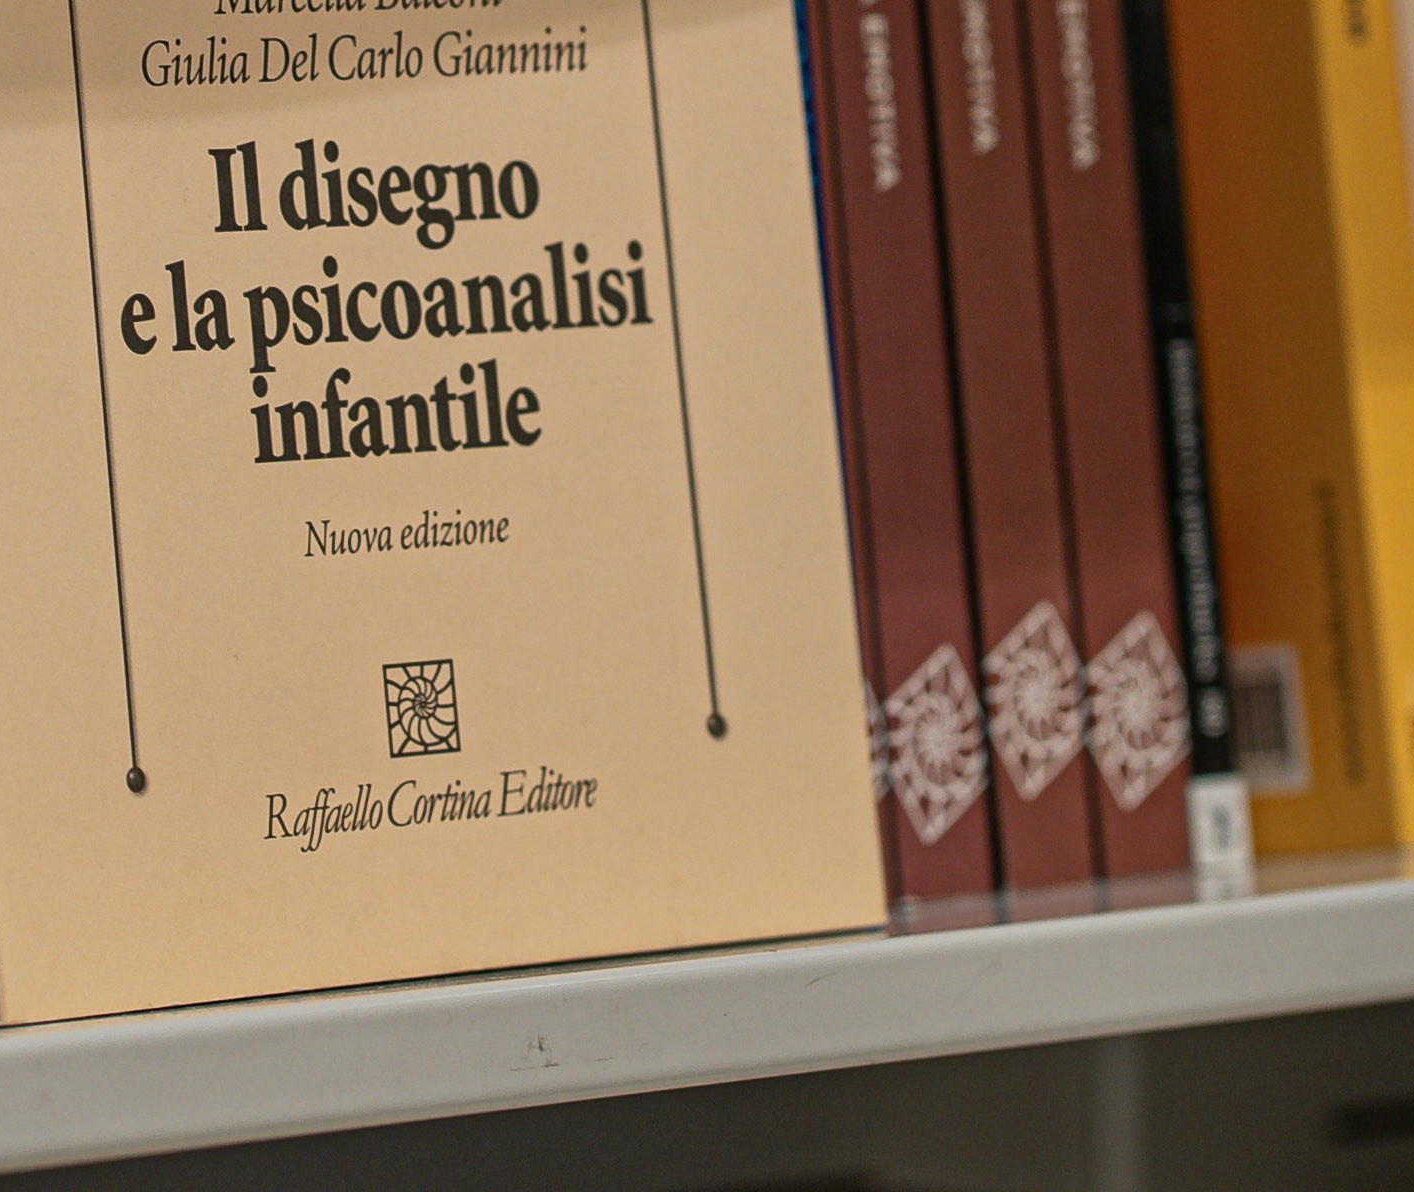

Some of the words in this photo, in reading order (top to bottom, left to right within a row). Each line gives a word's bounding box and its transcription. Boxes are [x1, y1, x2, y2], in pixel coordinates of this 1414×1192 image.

[141, 36, 250, 87] Giulia
[258, 34, 320, 83] Del
[328, 31, 423, 80] Carlo
[433, 24, 588, 78] Giannini
[208, 140, 268, 233] Il
[279, 138, 539, 250] disegno
[121, 292, 157, 355] e
[165, 260, 235, 352] la
[243, 239, 654, 374] psicoanalisi
[250, 358, 542, 465] infantile
[304, 519, 393, 557] Nuova
[400, 509, 509, 550] edizione
[264, 784, 383, 852] Raffaello
[385, 777, 492, 829] Cortina
[498, 765, 599, 818] Editore
